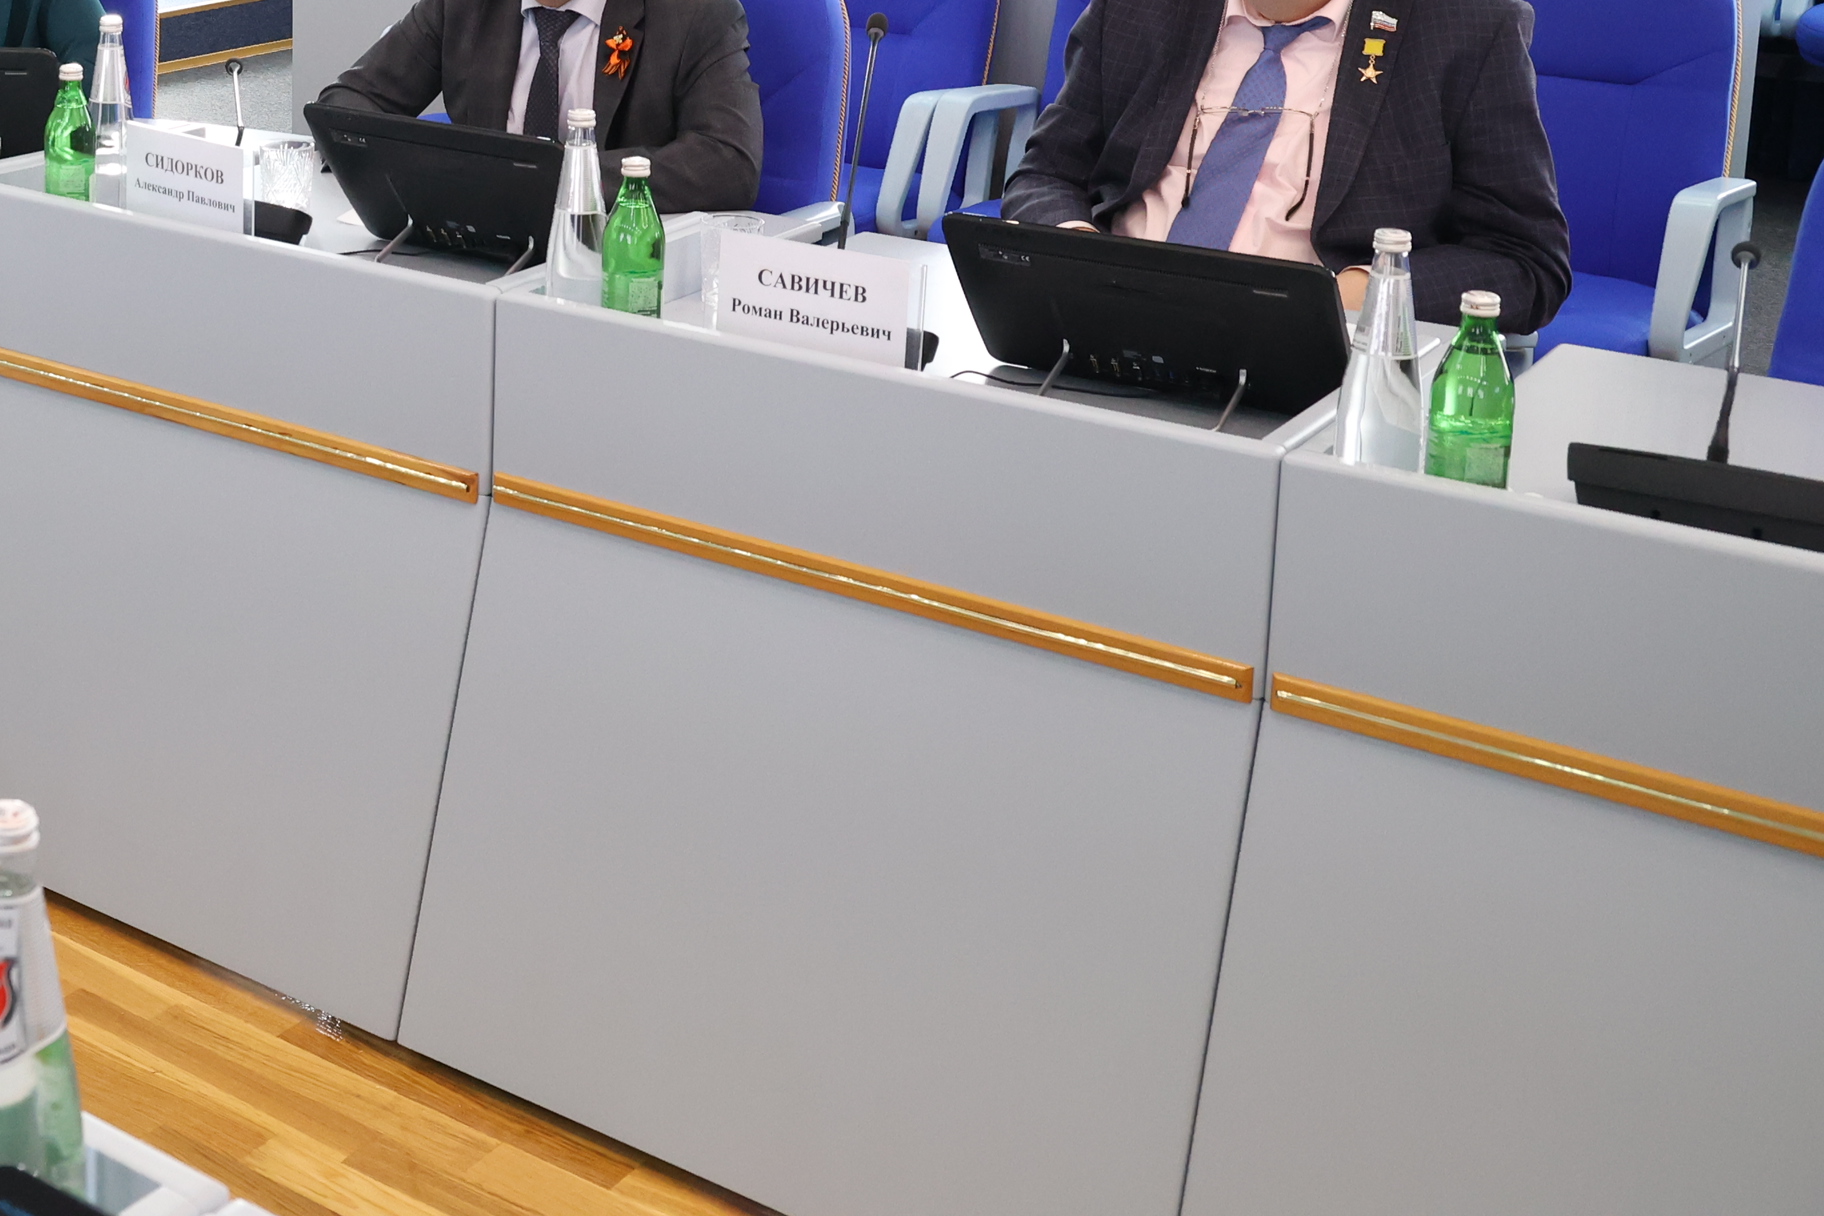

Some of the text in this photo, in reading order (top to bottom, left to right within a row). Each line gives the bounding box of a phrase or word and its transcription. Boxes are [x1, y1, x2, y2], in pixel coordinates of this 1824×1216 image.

[144, 151, 225, 186] СИДОРКОВ
[135, 177, 236, 213] Александр Павлович
[757, 268, 868, 304] САВИЧЕВ
[731, 296, 892, 341] Роман Валерьевич
